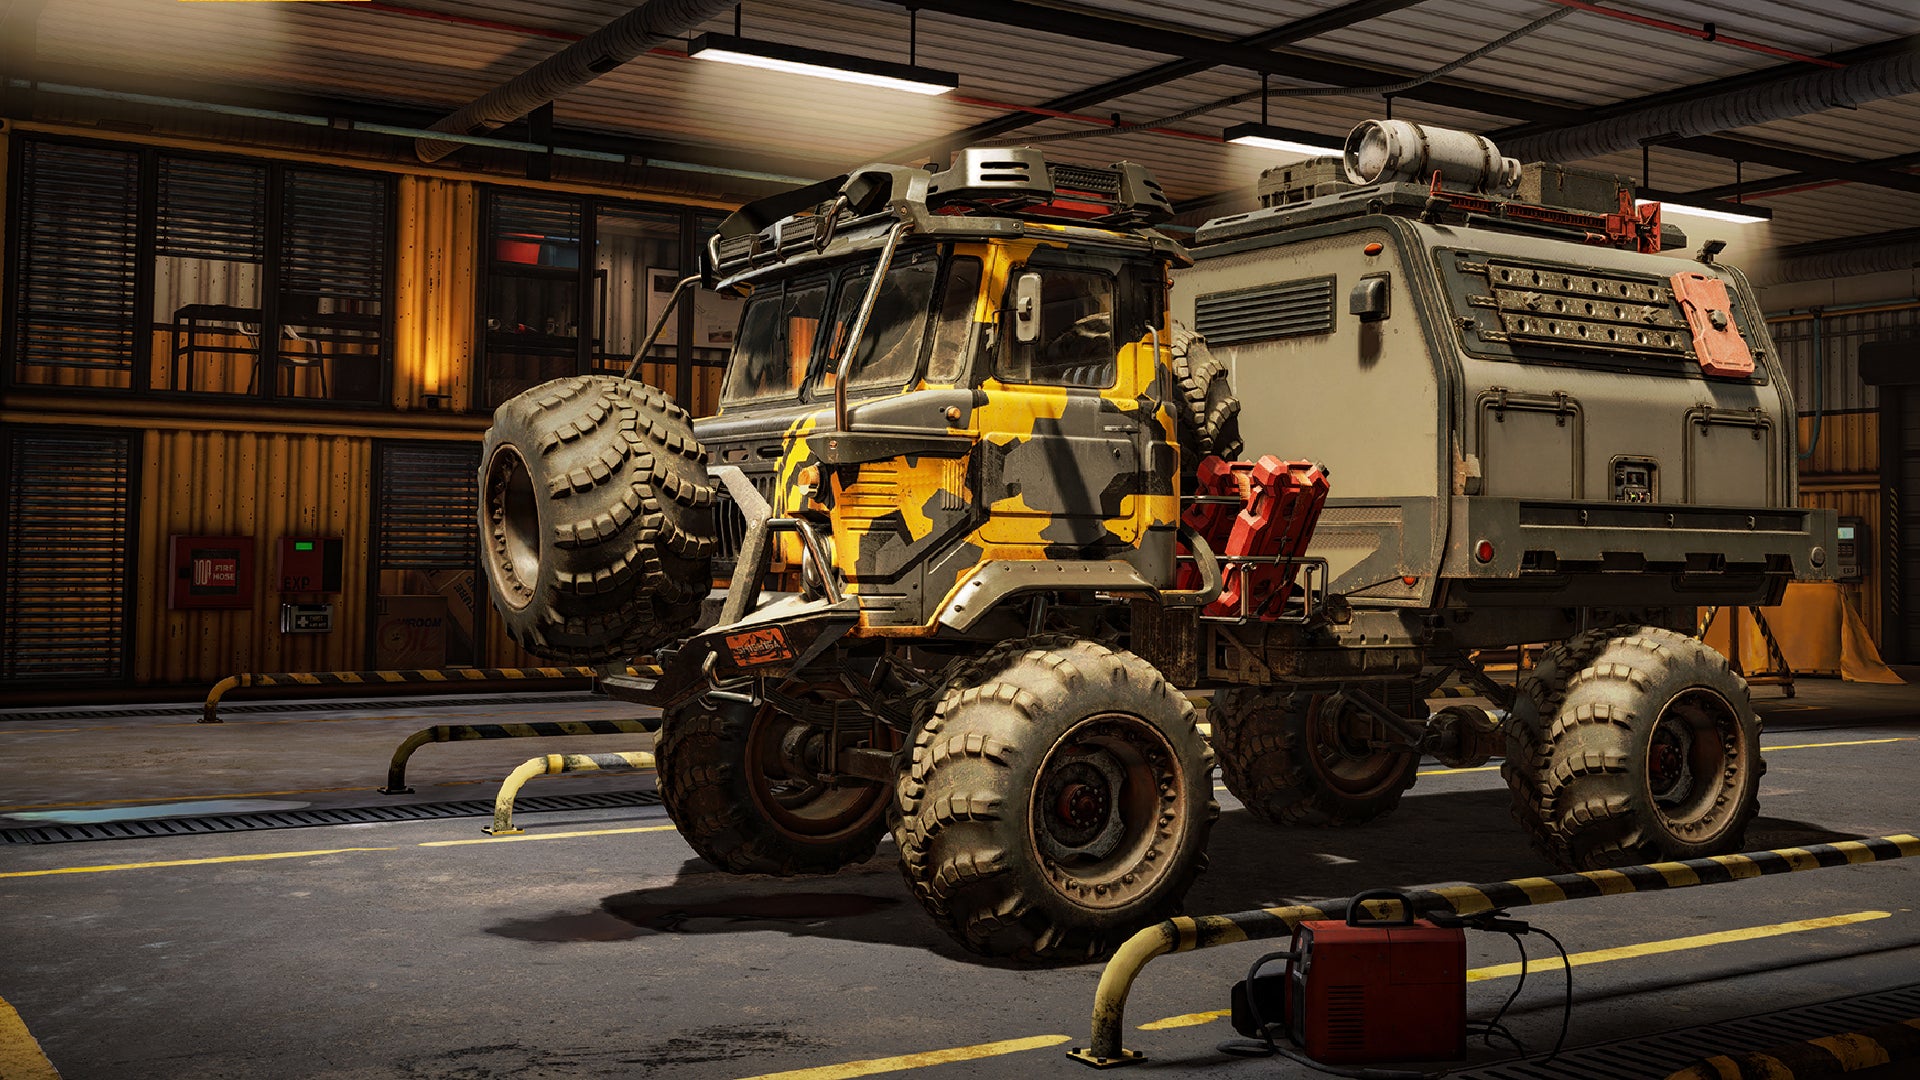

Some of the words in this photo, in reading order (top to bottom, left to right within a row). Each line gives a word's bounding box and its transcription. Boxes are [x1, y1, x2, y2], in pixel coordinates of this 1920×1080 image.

[214, 564, 234, 572] FIRE
[212, 573, 236, 581] HOSE
[284, 576, 311, 590] EXP
